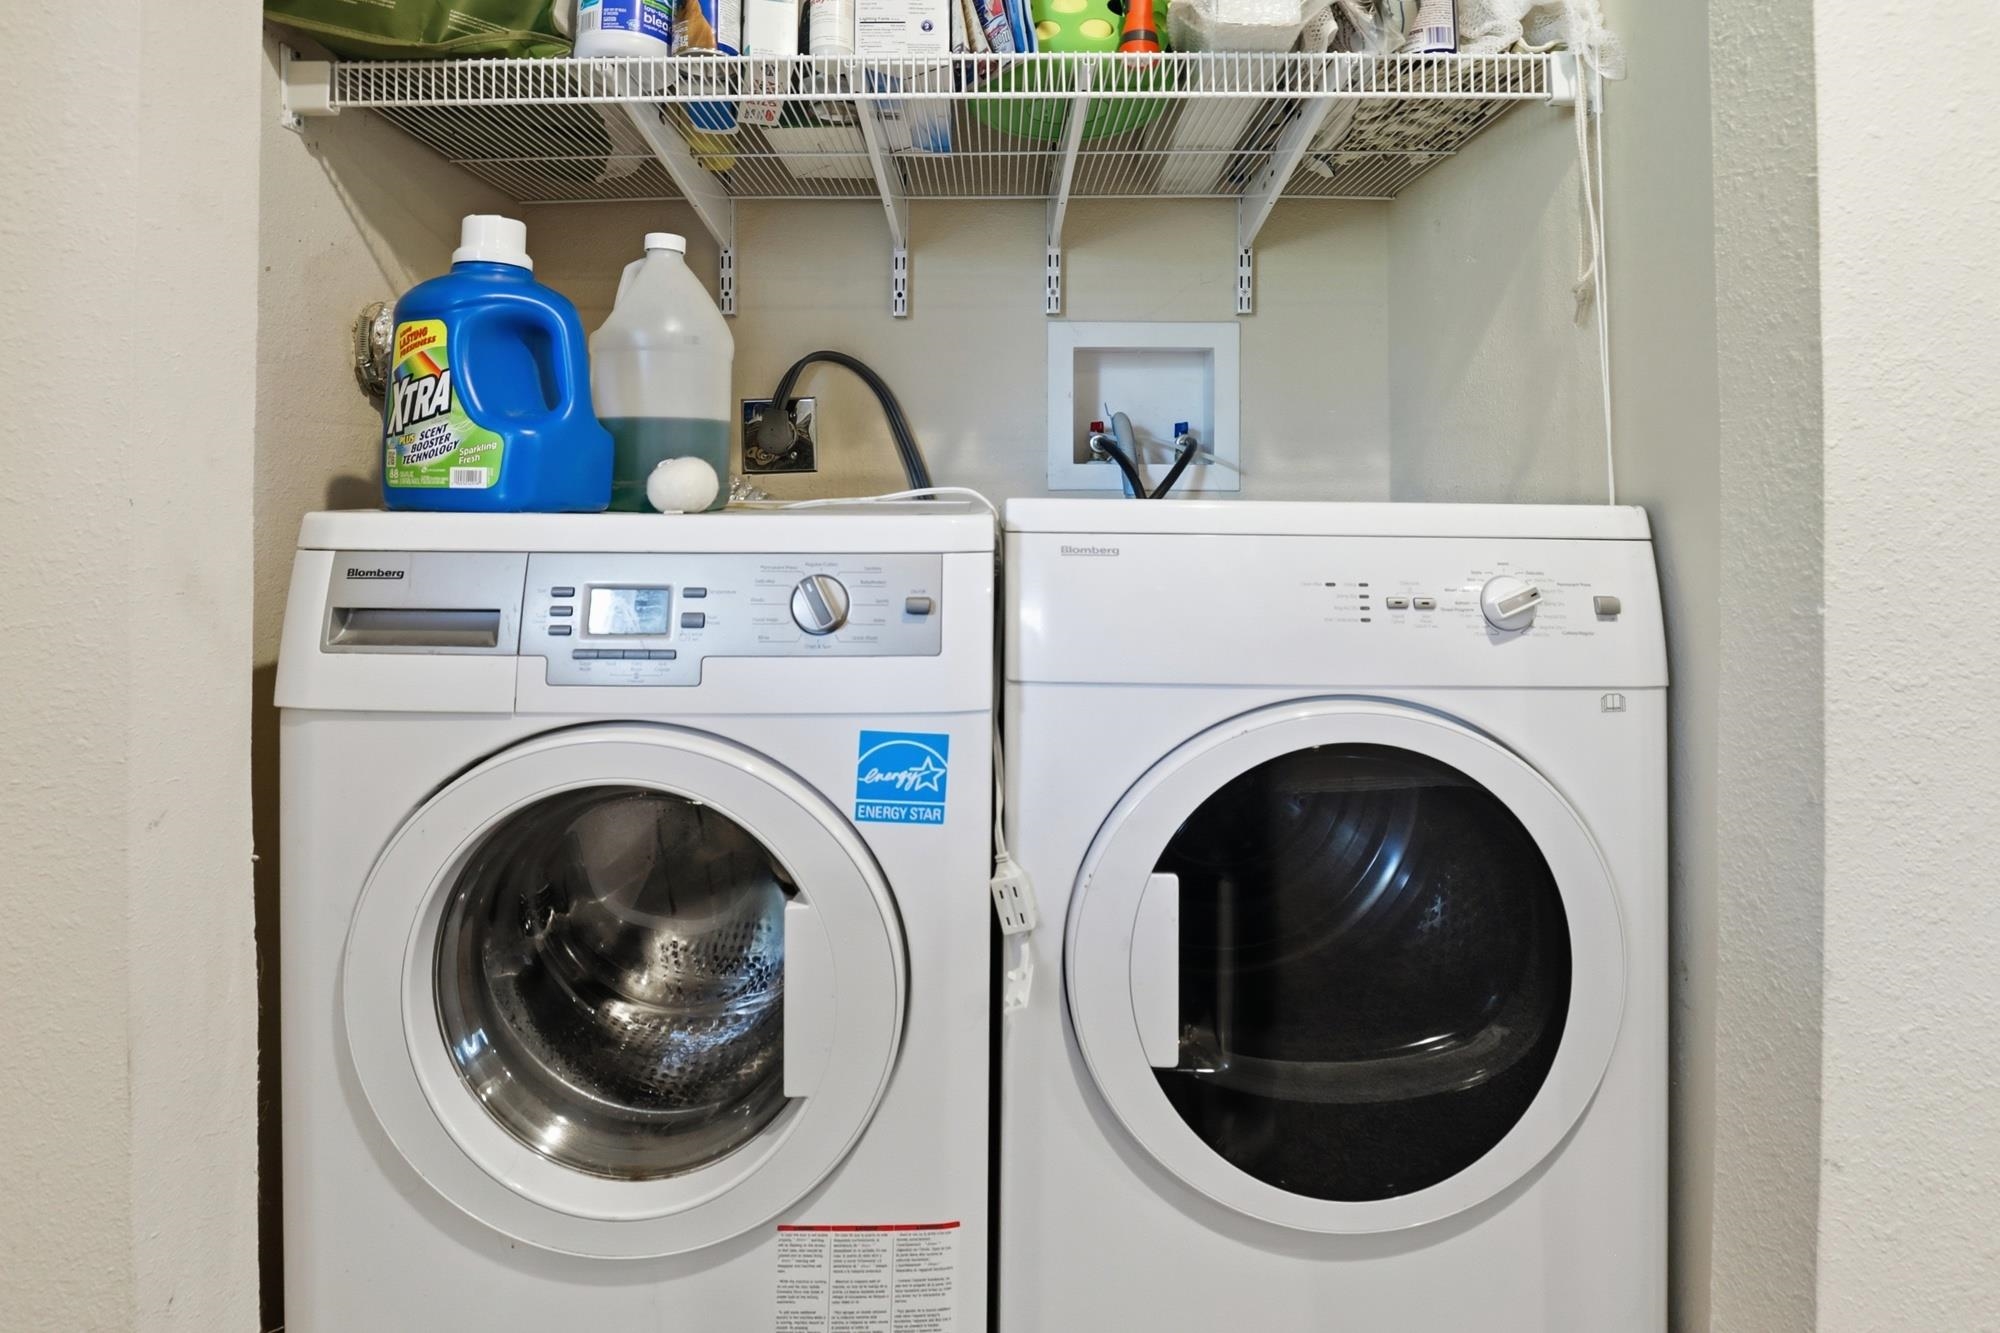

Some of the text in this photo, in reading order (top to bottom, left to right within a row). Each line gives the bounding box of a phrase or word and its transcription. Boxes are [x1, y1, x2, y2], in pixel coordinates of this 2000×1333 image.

[400, 326, 428, 349] LASTING
[387, 369, 452, 436] XTRA
[399, 423, 449, 445] PLUS SCENT
[410, 432, 452, 454] BOOSTER
[402, 439, 460, 465] TECHNOLOGY
[459, 441, 498, 457] Sparkling
[458, 454, 481, 465] Fresh
[1060, 545, 1120, 557] Blomberg
[346, 568, 405, 580] Blomberg
[857, 805, 942, 821] ENERGY STAR
